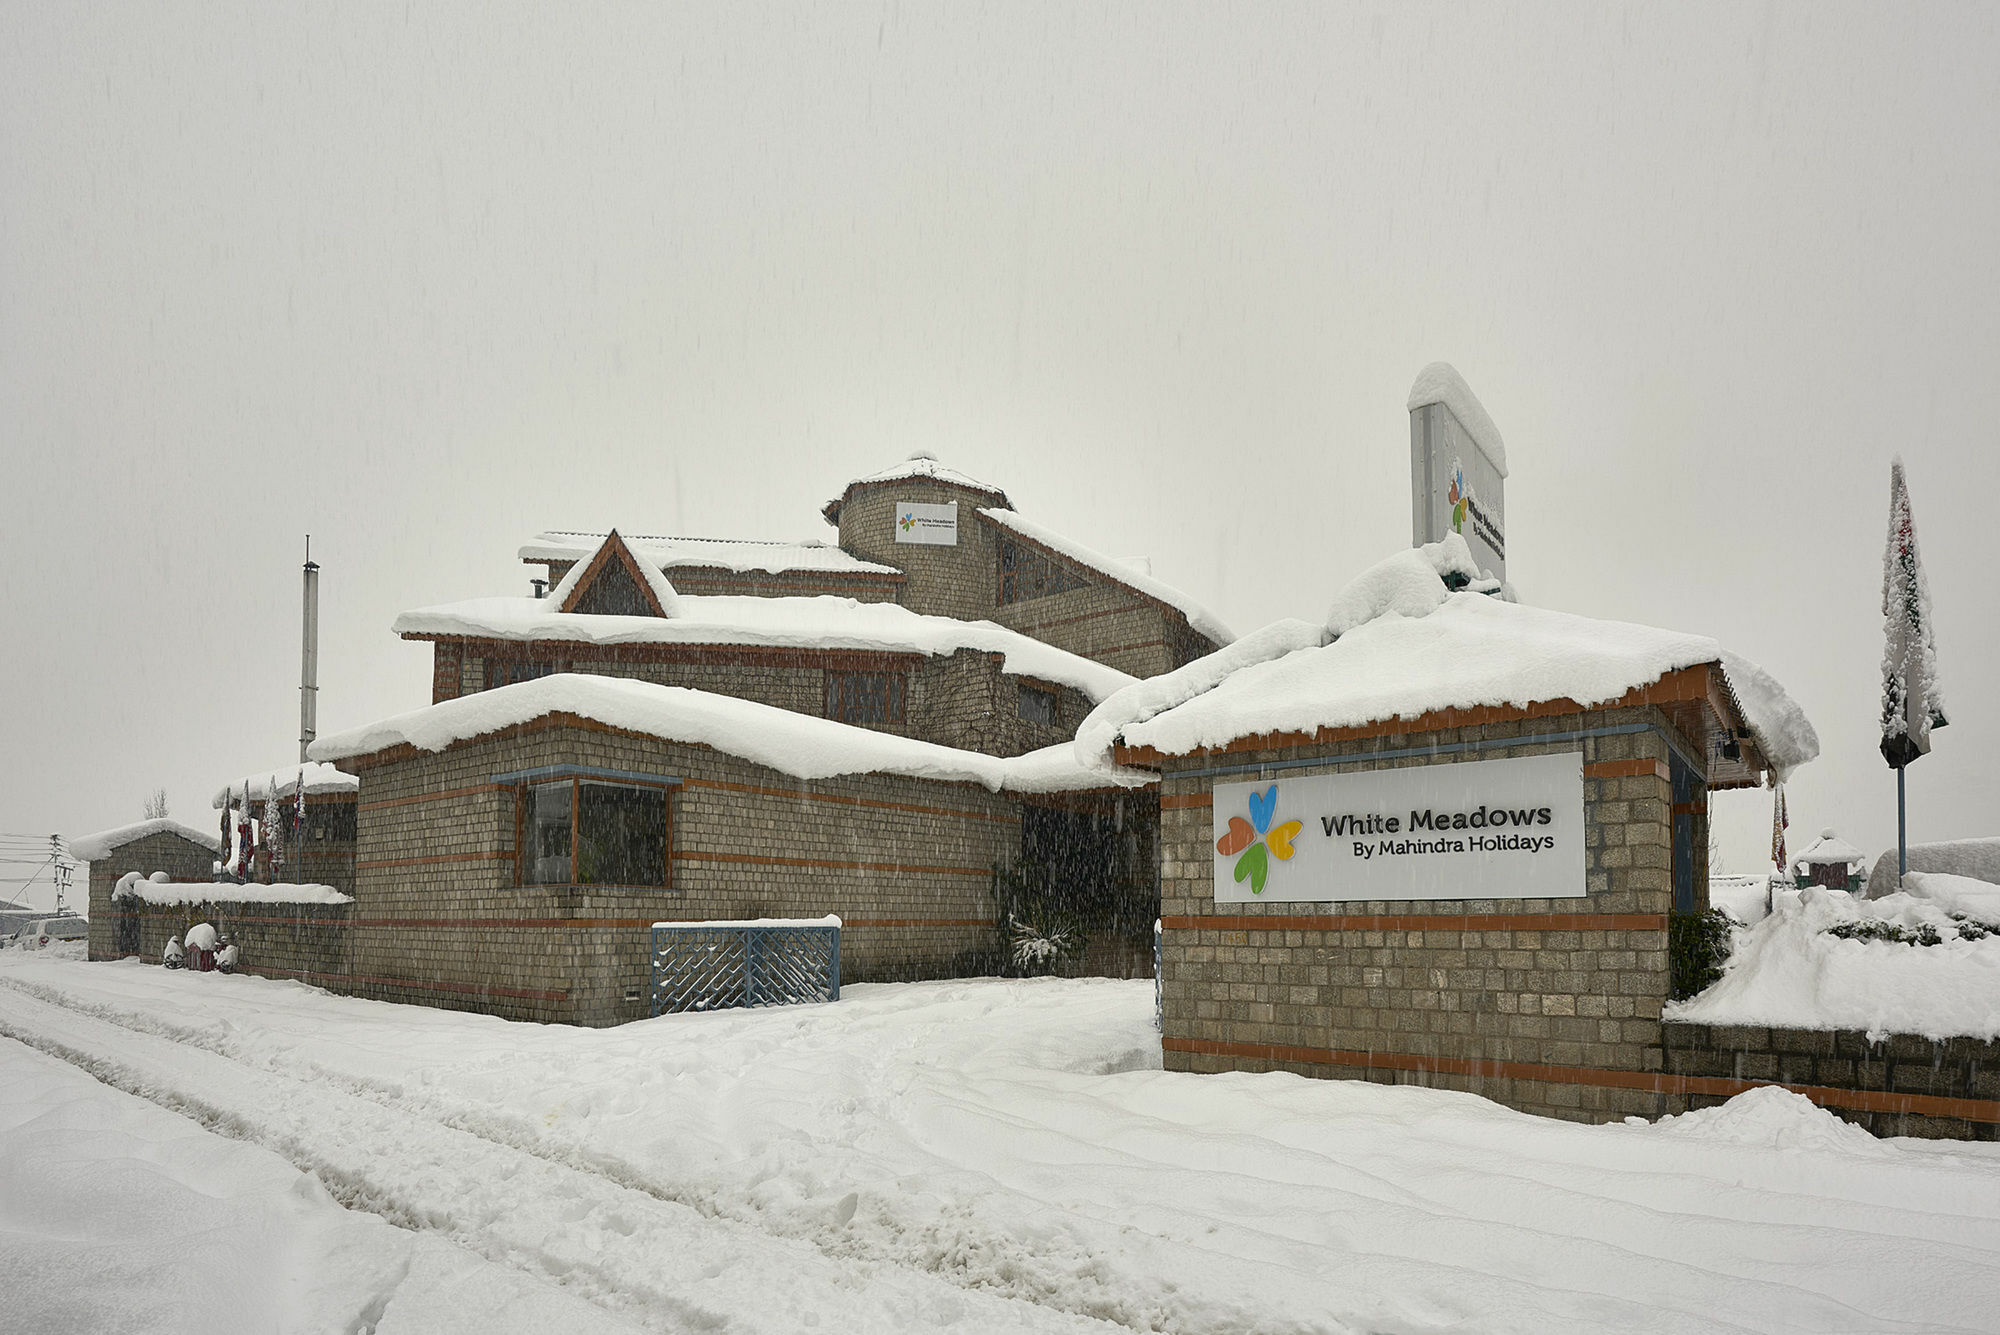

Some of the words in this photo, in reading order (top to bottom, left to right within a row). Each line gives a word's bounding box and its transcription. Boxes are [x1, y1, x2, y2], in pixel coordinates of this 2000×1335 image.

[1320, 813, 1400, 837] White
[1408, 805, 1552, 832] Meadows
[1352, 841, 1375, 860] By
[1378, 838, 1465, 856] Mahindra
[1468, 834, 1555, 854] Holidays
